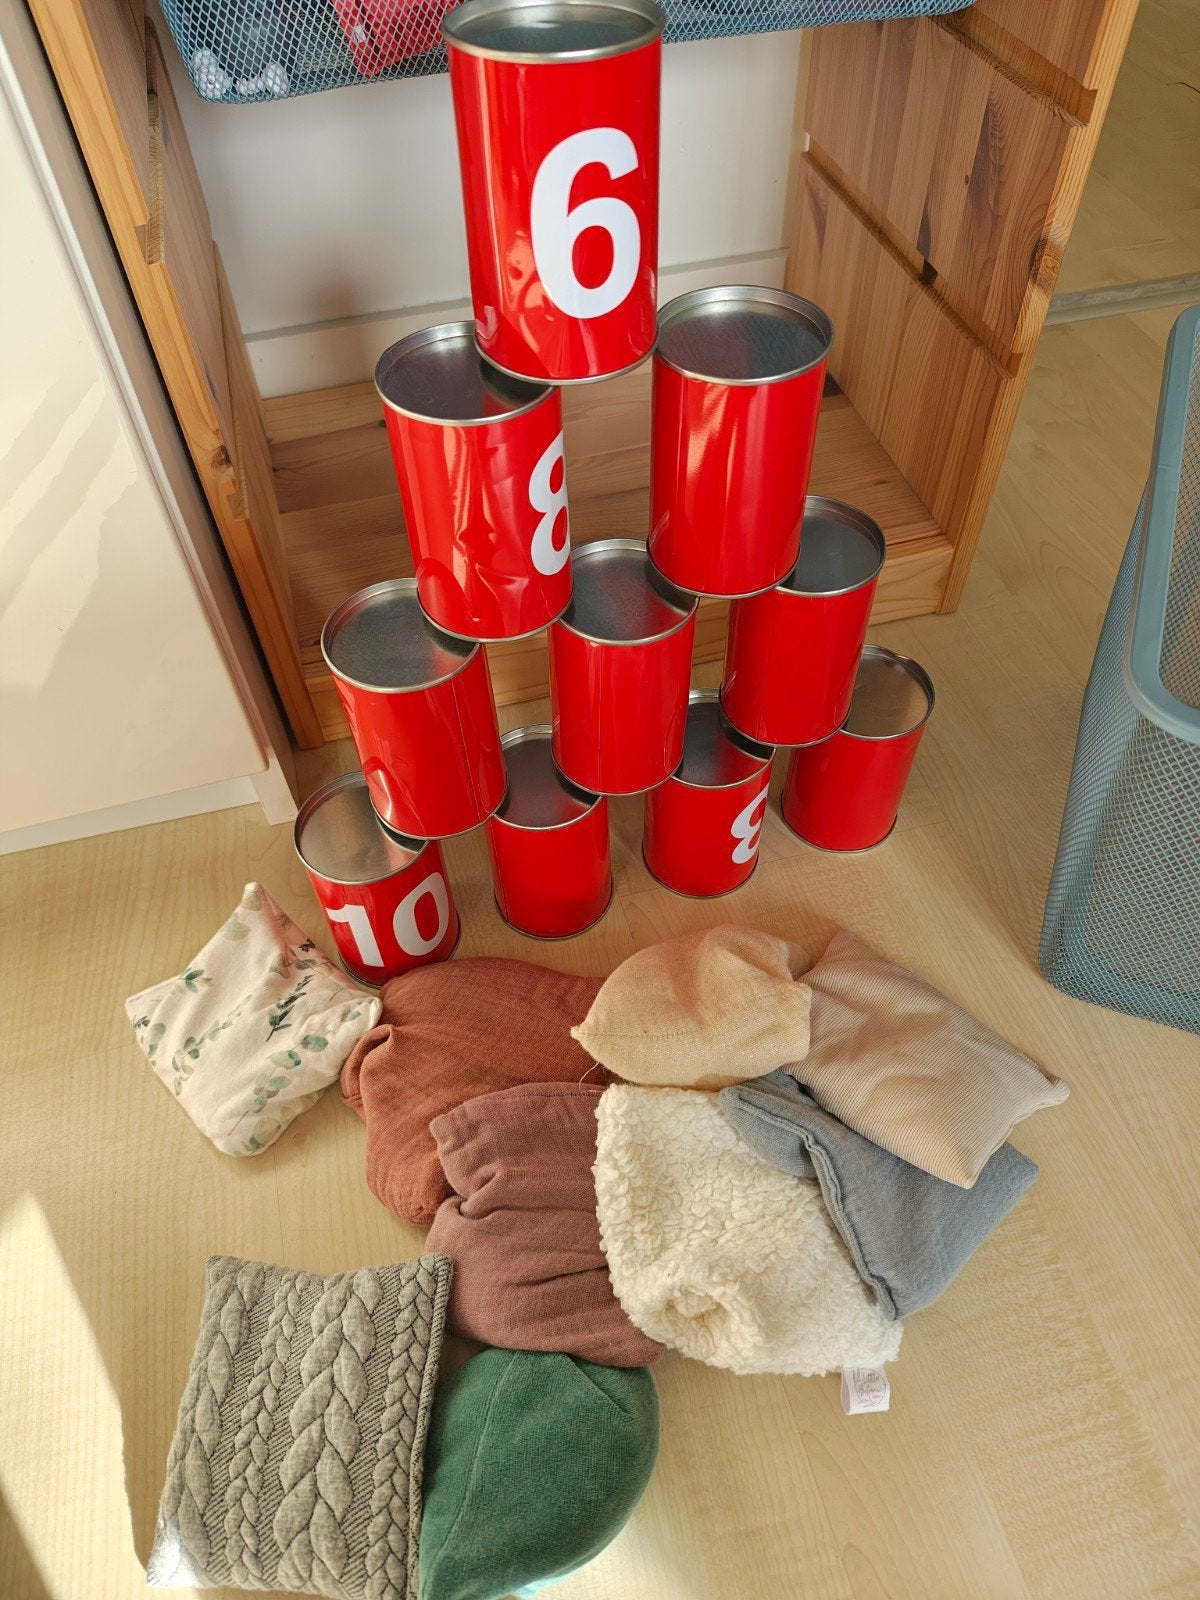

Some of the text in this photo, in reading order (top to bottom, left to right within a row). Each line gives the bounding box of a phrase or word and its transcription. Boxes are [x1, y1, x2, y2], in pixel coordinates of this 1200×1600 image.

[531, 127, 641, 319] 6
[529, 430, 571, 576] 8
[325, 872, 449, 967] 10
